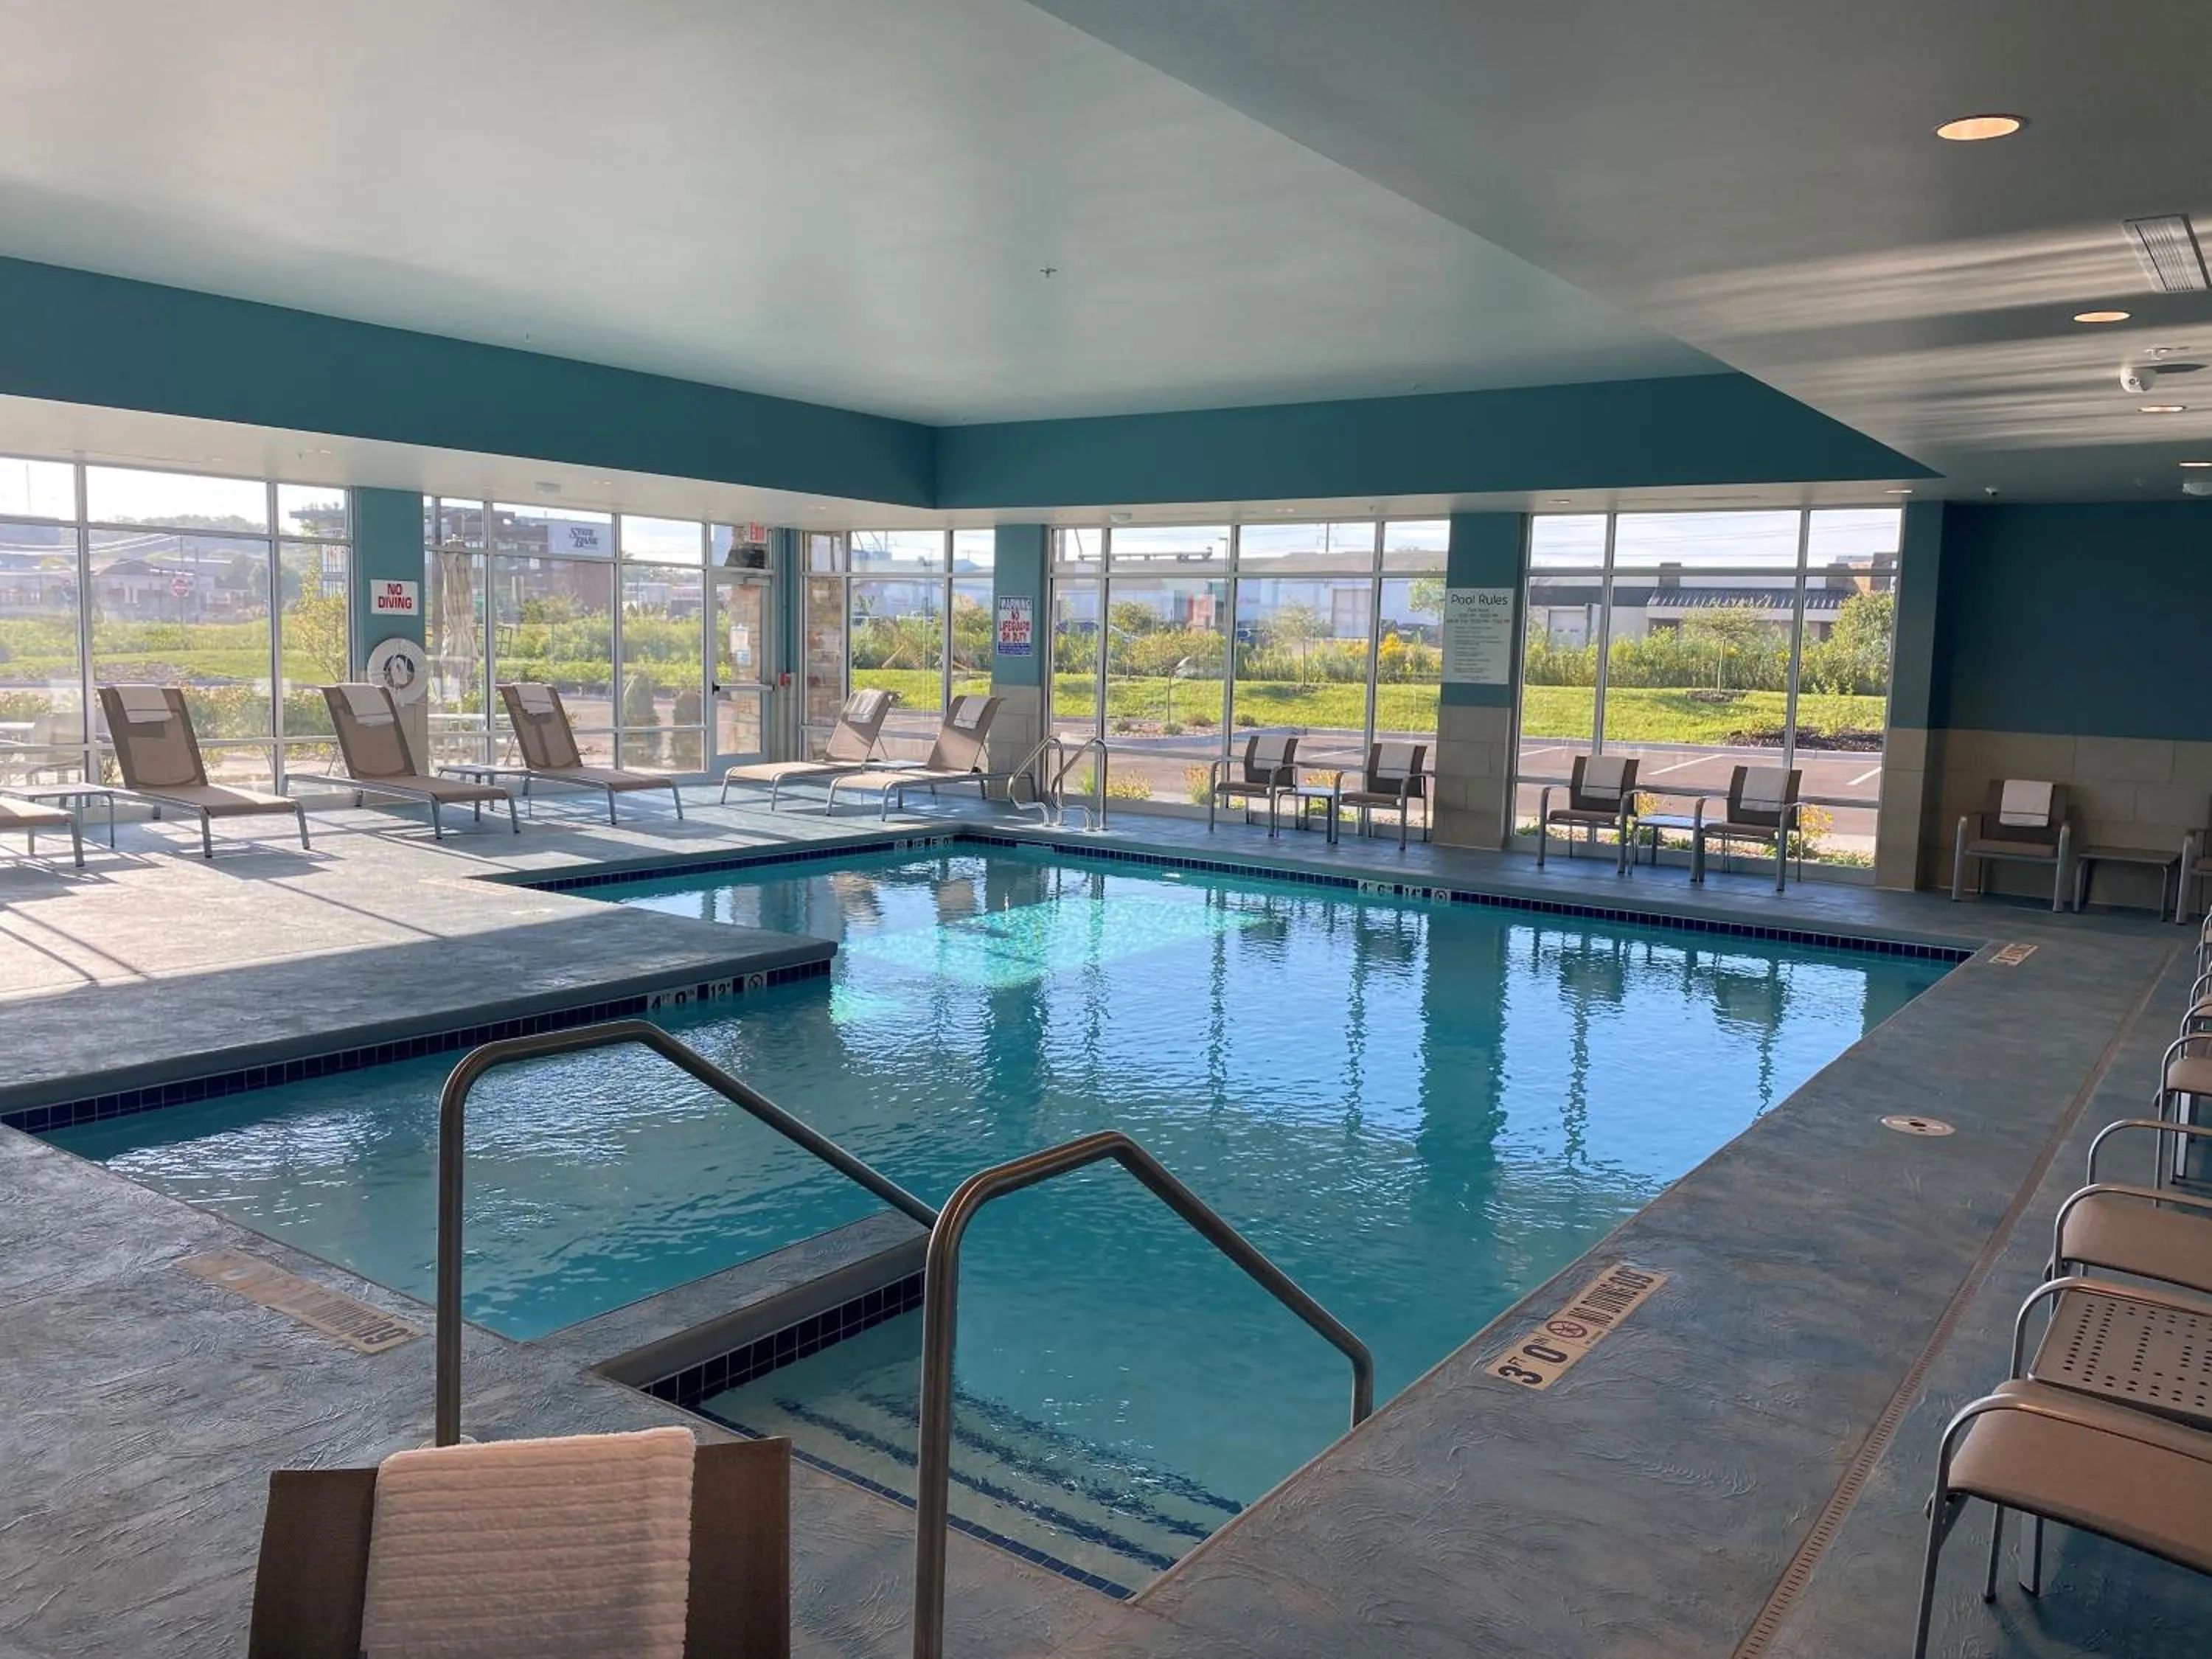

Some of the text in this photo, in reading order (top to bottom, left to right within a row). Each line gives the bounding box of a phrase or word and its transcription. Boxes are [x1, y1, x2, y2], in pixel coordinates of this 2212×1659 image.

[387, 583, 402, 595] NO
[378, 596, 412, 609] DIVING
[1450, 593, 1509, 605] Pool Rules
[999, 620, 1030, 632] LIFEGUARD
[1012, 631, 1027, 643] DUTY
[1567, 1283, 1639, 1326] NO DIVING
